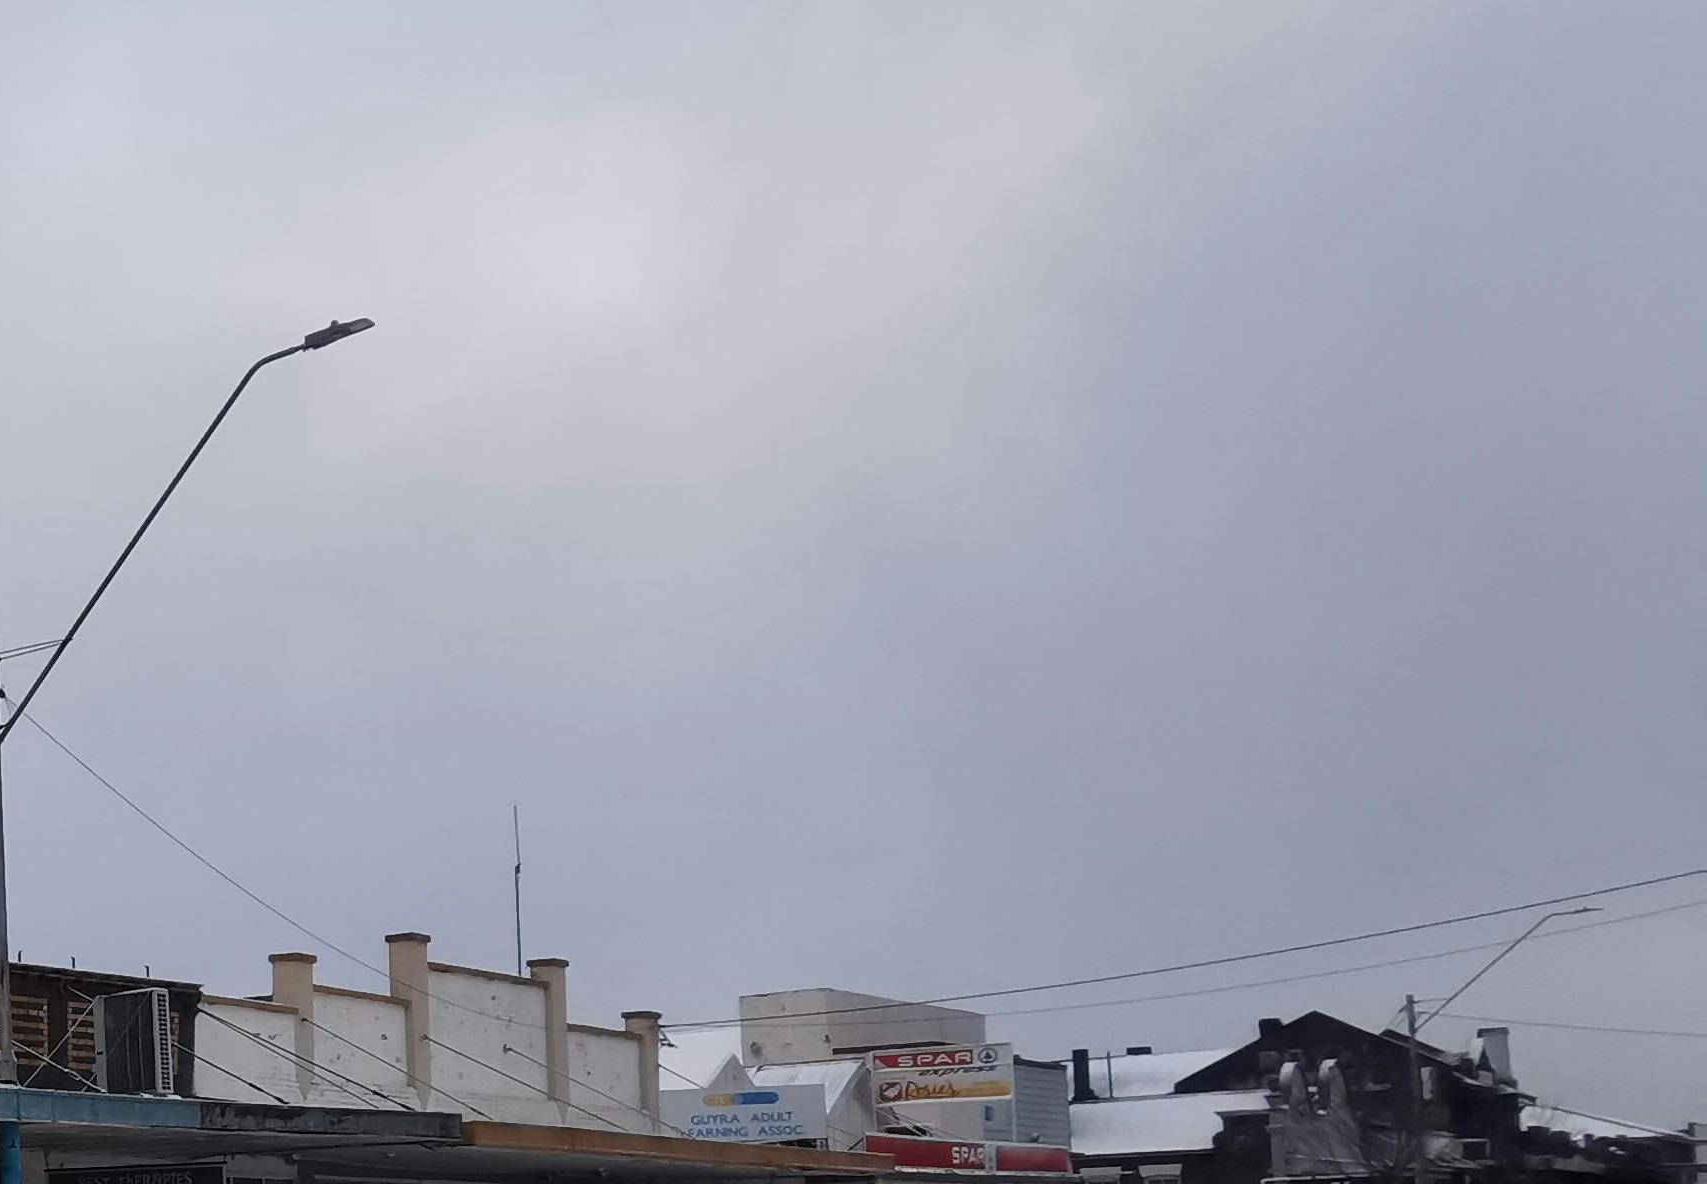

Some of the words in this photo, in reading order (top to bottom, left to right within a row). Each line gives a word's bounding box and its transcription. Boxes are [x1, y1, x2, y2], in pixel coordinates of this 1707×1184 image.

[897, 1052, 971, 1067] SPAR
[918, 1065, 998, 1077] express
[690, 1114, 740, 1125] GUYRA
[751, 1111, 793, 1122] ADULT
[684, 1127, 748, 1138] EARNING
[758, 1125, 803, 1136] ASSOC
[951, 1146, 984, 1164] SPAR
